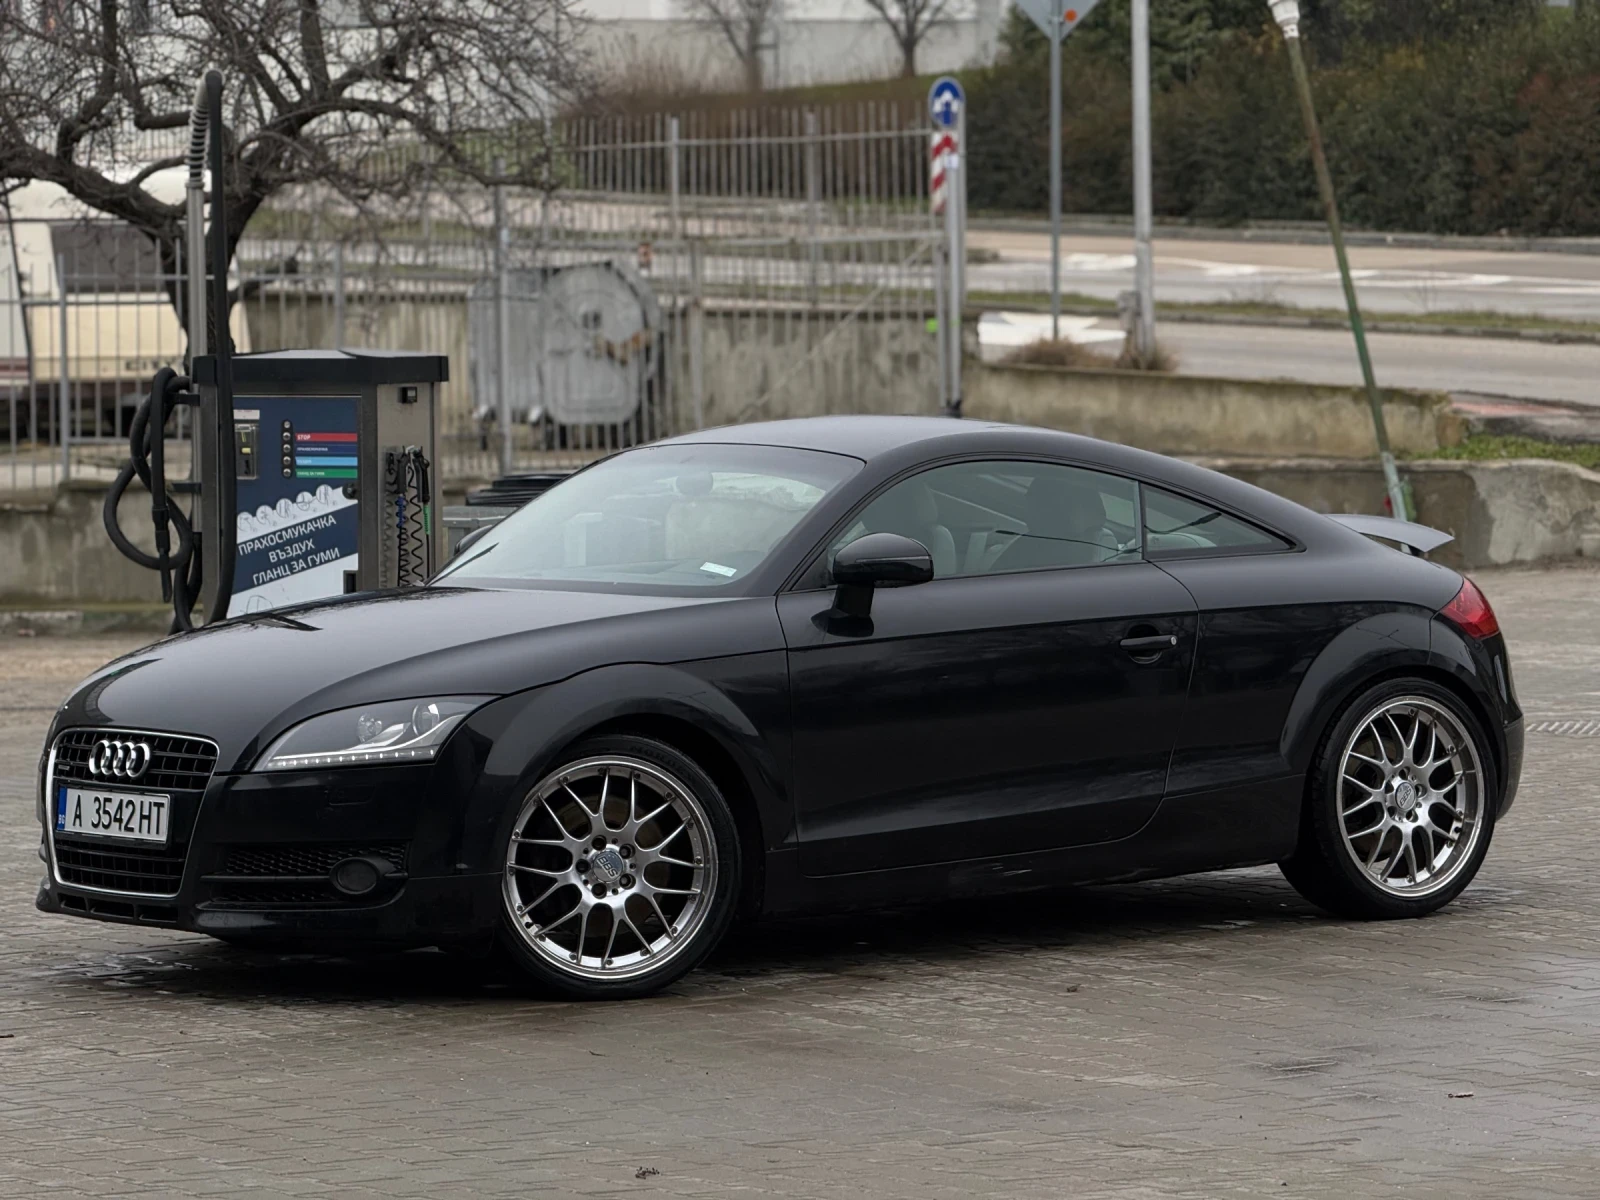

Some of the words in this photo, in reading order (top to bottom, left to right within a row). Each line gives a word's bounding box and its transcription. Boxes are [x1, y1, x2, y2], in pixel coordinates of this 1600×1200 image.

[238, 514, 337, 556] ПРАХОСМУКАЧКА
[268, 538, 316, 563] ВЪЗДУХ
[252, 563, 291, 585] ГЛАНЦ
[290, 558, 307, 573] ЗА
[307, 547, 340, 567] ГУМИ
[1400, 787, 1412, 807] BBS
[72, 794, 83, 828] A
[91, 796, 165, 835] 3542HT
[598, 856, 619, 878] BBS
